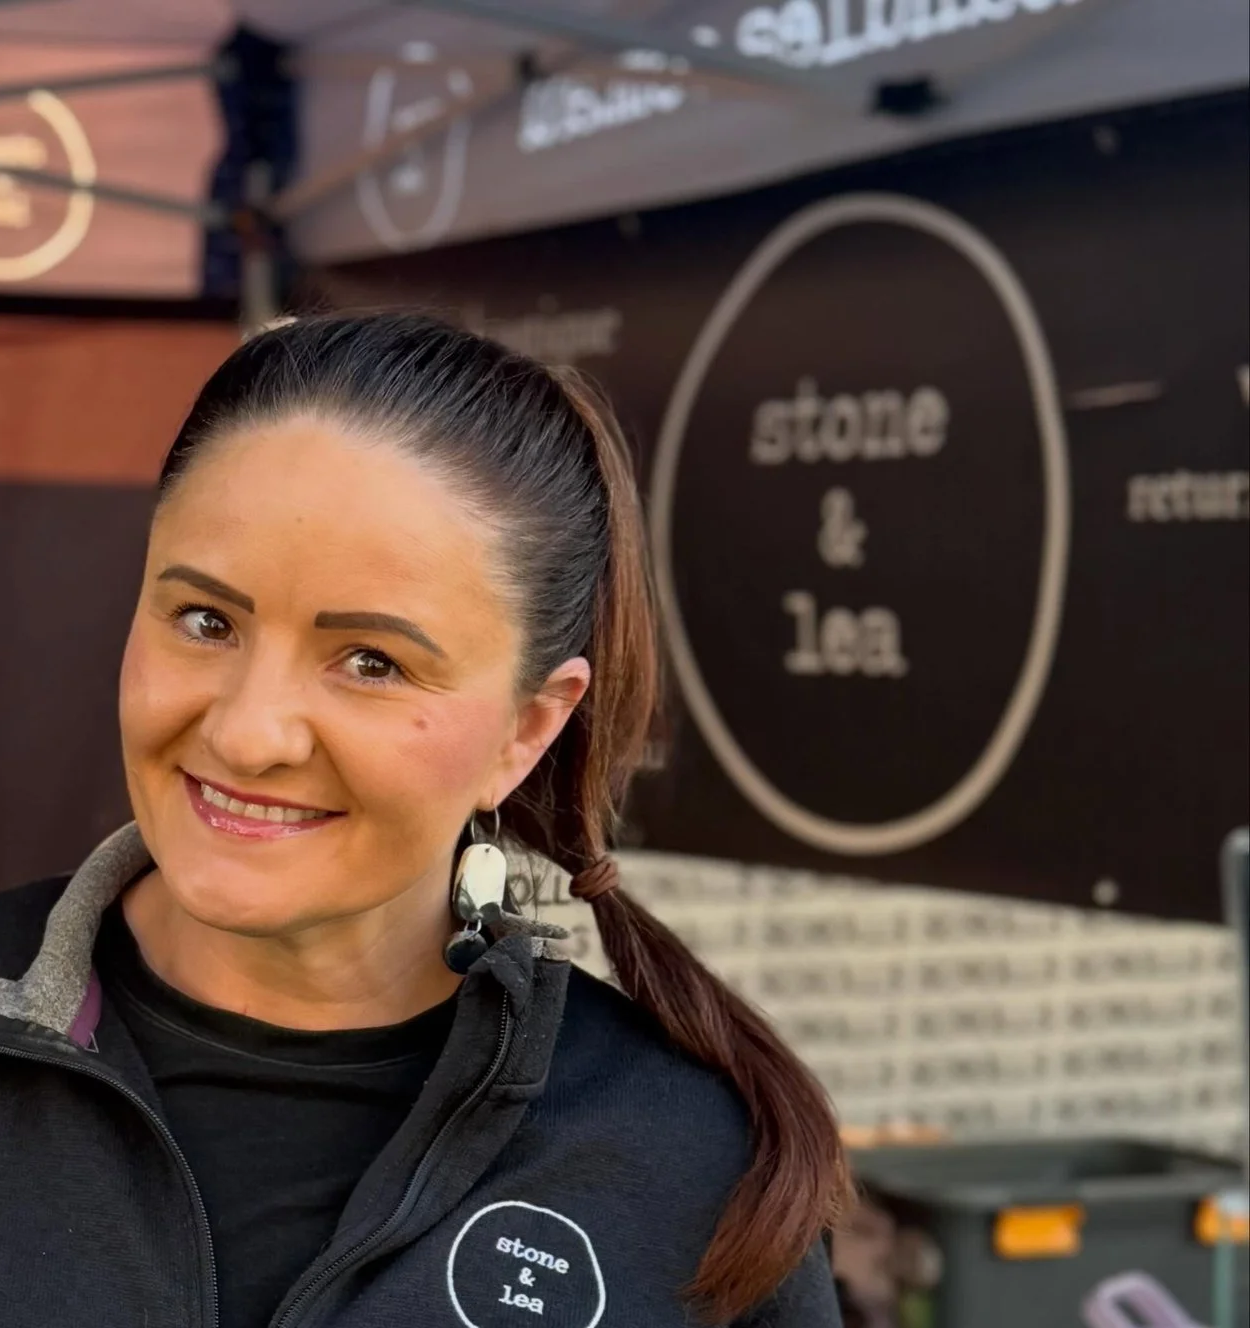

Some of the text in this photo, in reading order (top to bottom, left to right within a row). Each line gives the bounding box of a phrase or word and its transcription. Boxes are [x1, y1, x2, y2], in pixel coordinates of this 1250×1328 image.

[750, 382, 950, 464] stone
[817, 486, 866, 568] &
[782, 590, 908, 677] lea
[495, 1236, 570, 1275] stone
[518, 1267, 536, 1287] &
[498, 1284, 544, 1316] lea
